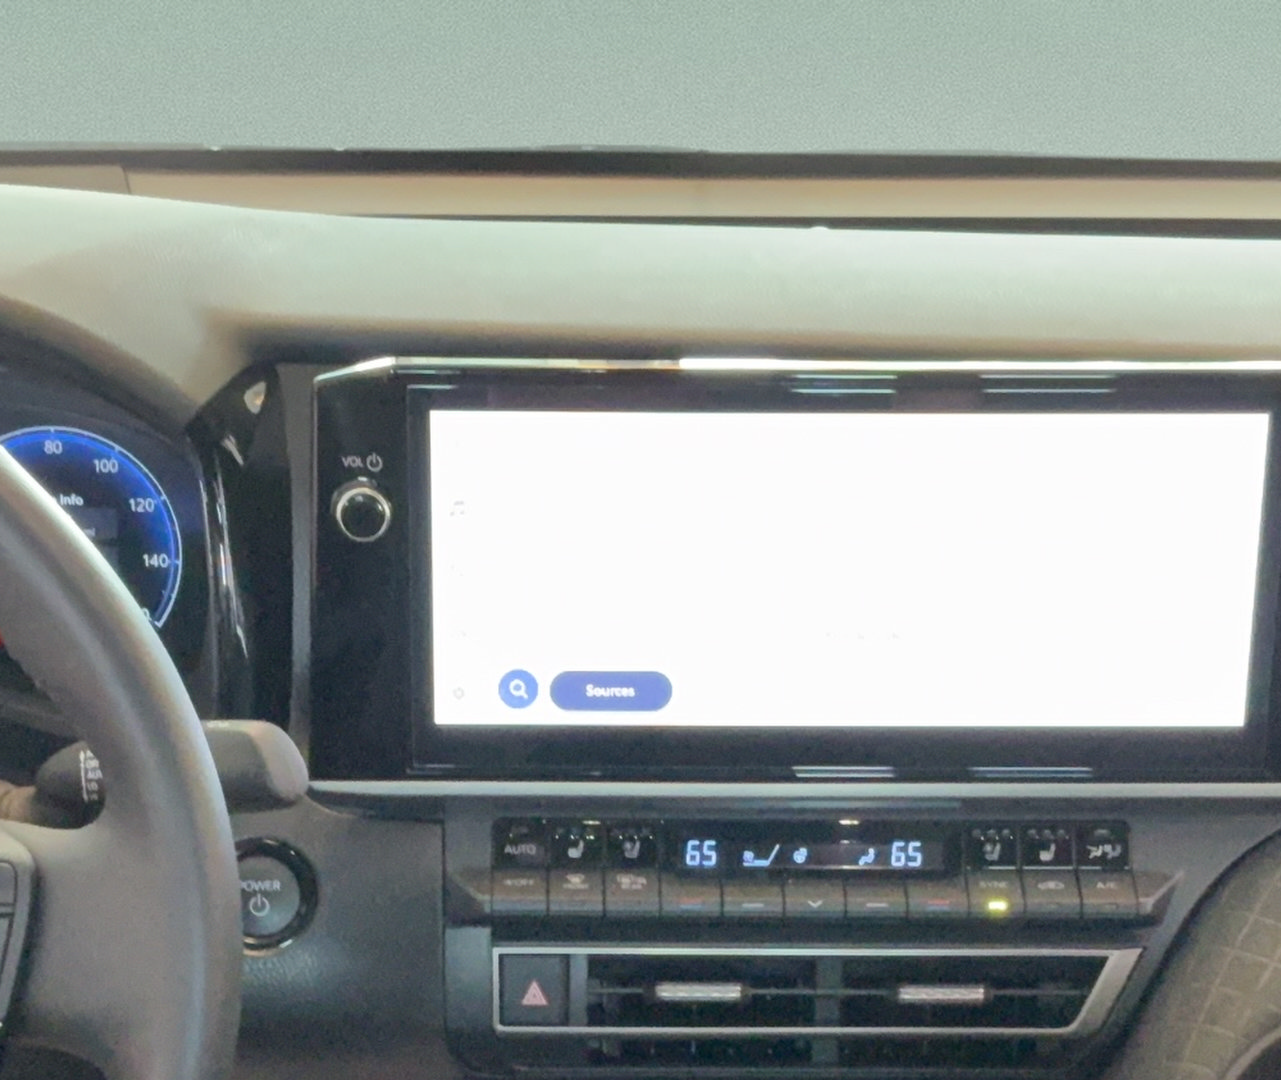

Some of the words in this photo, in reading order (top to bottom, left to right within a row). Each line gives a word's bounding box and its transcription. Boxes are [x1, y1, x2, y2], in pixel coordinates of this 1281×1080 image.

[44, 441, 63, 454] 80
[93, 459, 118, 473] 100
[341, 456, 363, 468] VOL
[60, 493, 84, 506] Info
[129, 498, 155, 512] 120
[142, 554, 170, 568] 140
[585, 683, 636, 698] Sources
[504, 844, 536, 856] AUTO
[685, 840, 717, 866] 65
[890, 841, 922, 868] 65
[979, 881, 1008, 889] SYNC
